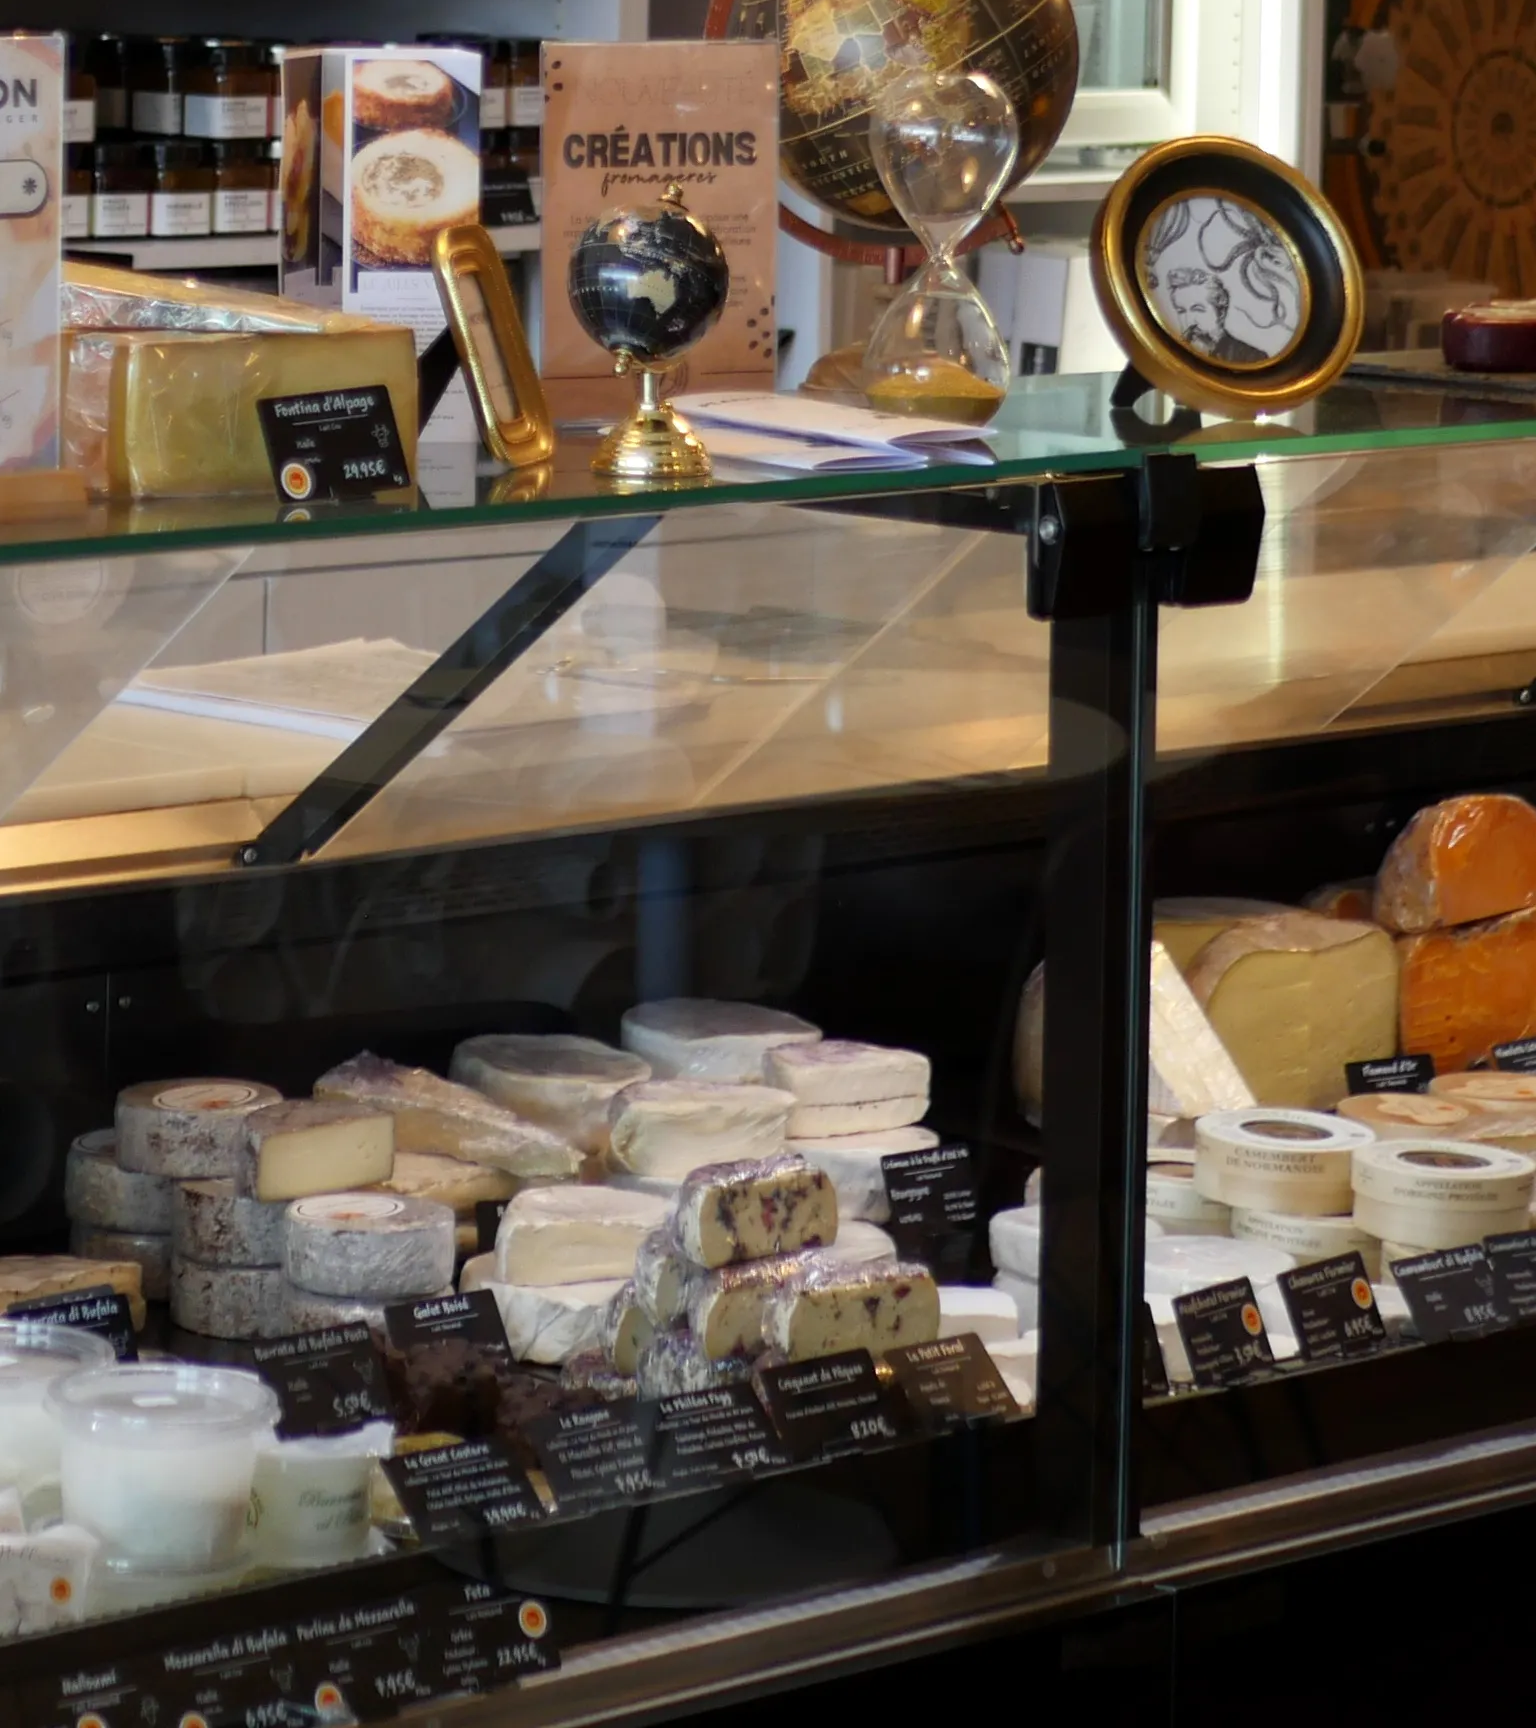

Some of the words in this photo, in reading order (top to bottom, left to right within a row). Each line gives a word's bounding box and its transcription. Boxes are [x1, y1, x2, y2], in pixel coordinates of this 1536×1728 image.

[563, 124, 758, 168] CRÉATIONS
[273, 400, 321, 419] Fontina
[322, 392, 376, 415] d'Alpage
[342, 458, 387, 480] 29.95€
[81, 1298, 119, 1320] Bufala
[163, 1641, 230, 1672] Mozzarella
